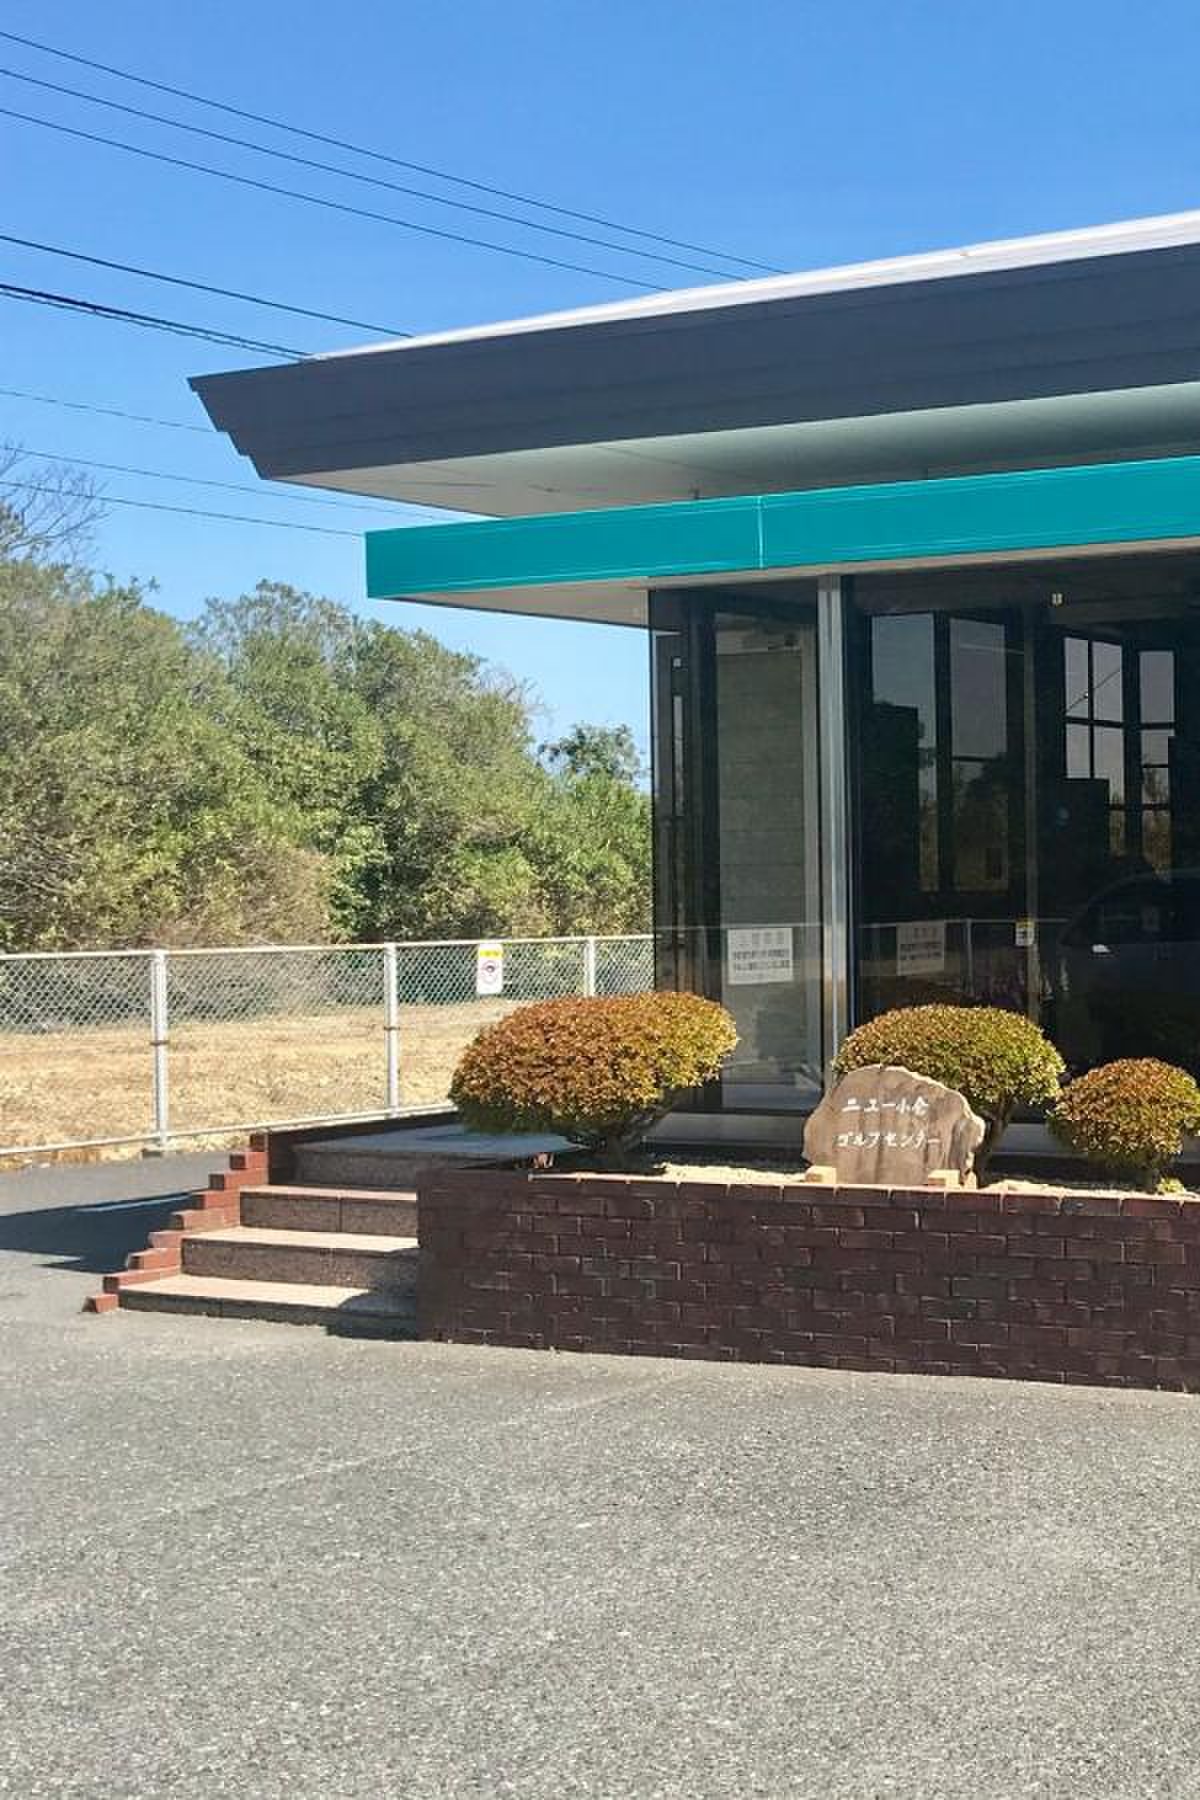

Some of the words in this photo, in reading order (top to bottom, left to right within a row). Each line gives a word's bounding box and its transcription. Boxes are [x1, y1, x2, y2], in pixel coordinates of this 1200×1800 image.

[836, 1130, 941, 1149] ゴルフセンター
